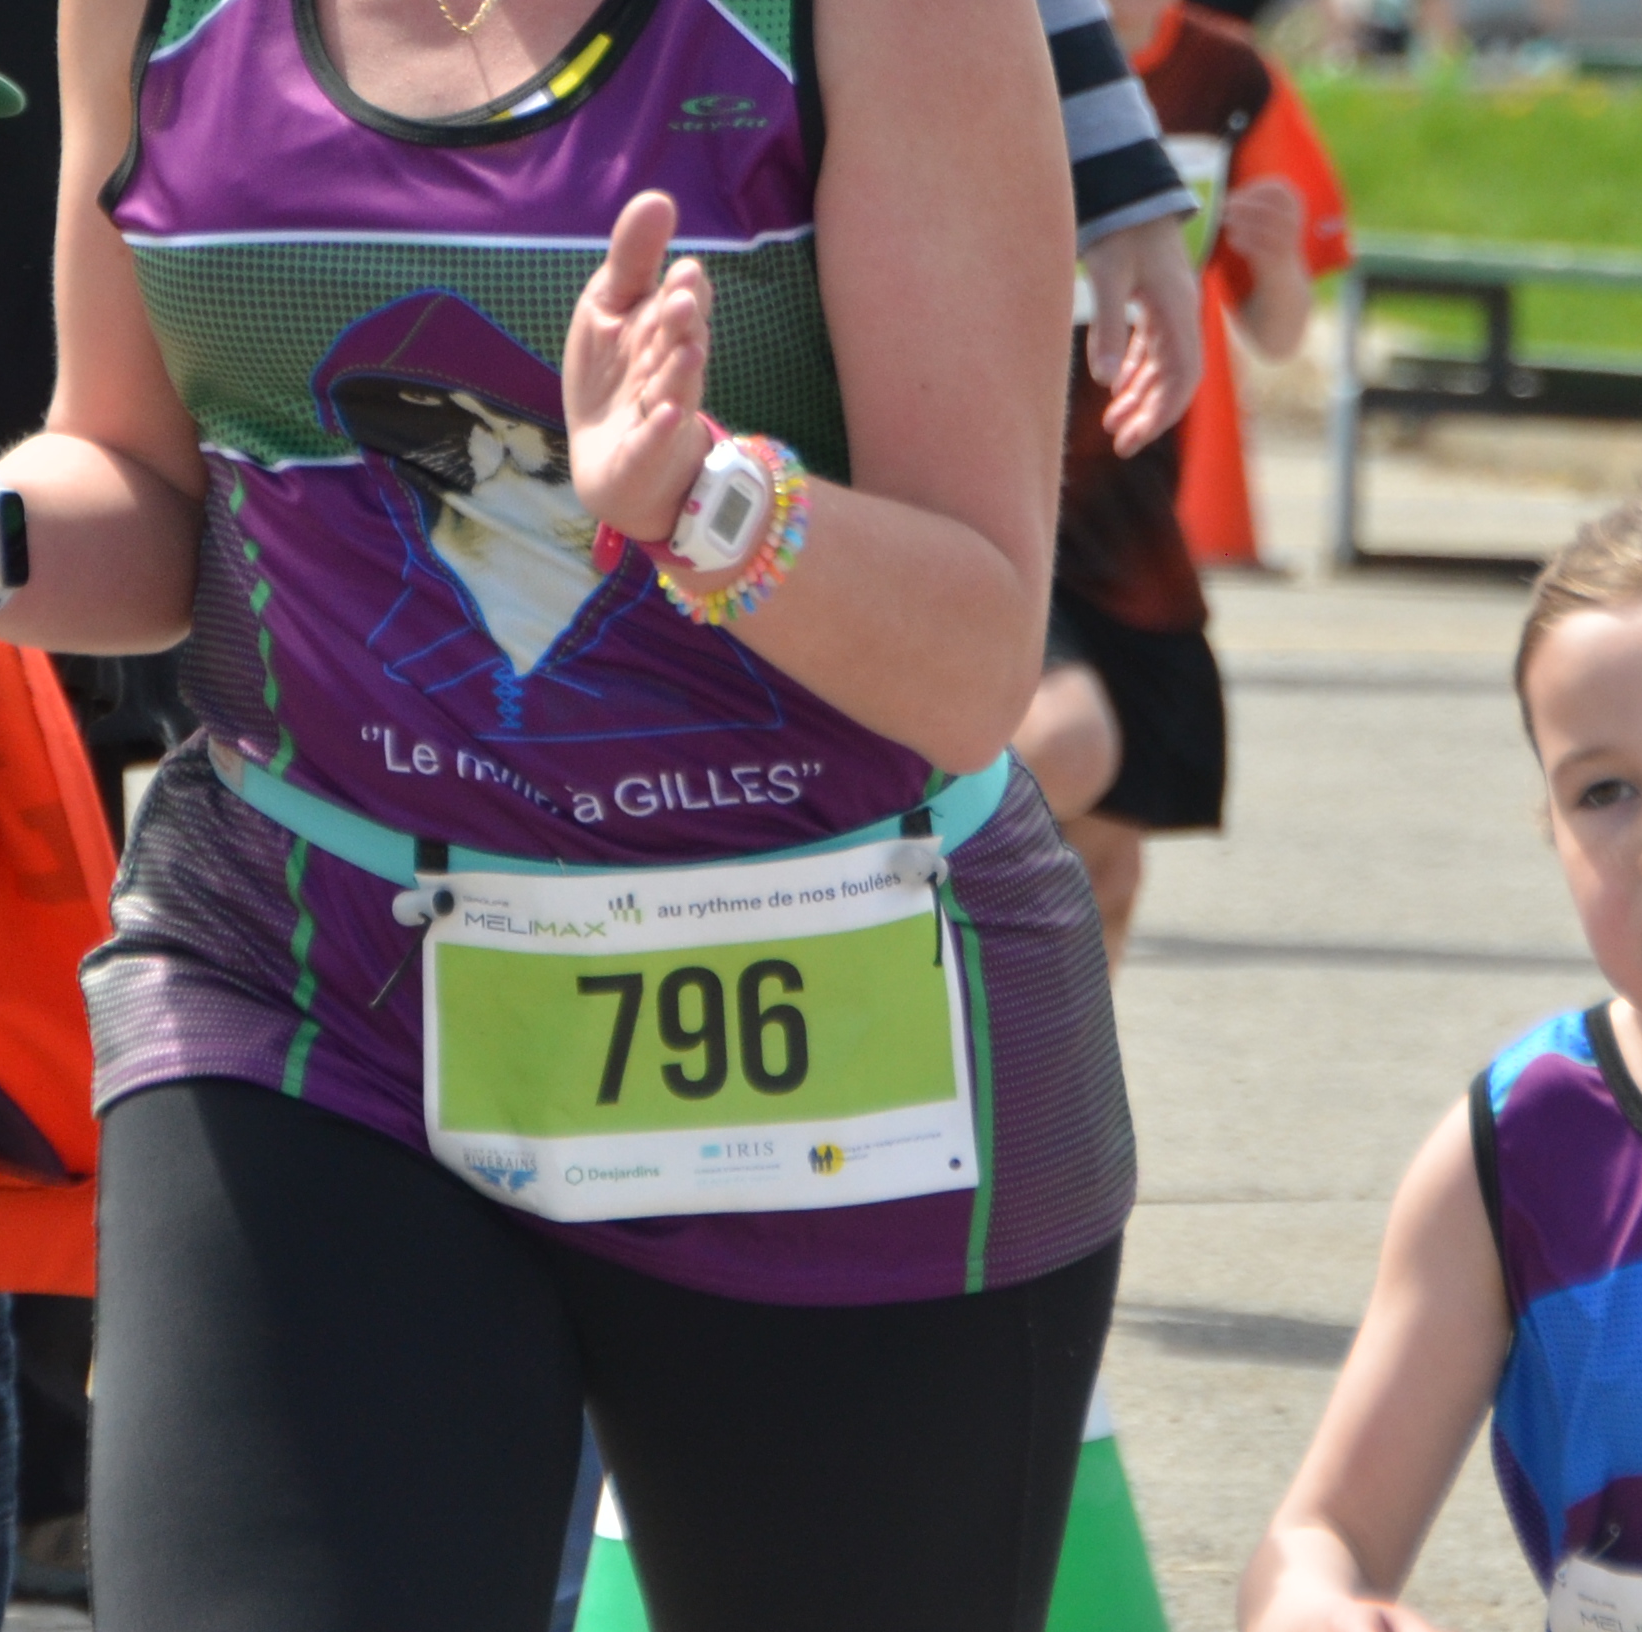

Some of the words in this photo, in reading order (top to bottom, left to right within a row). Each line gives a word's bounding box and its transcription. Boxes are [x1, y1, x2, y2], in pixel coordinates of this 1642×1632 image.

[657, 904, 682, 919] au
[688, 895, 762, 919] rythme
[768, 890, 794, 909] de
[799, 885, 836, 905] nos
[841, 872, 902, 899] foulées
[576, 958, 810, 1107] 796
[726, 1141, 775, 1159] IRIS
[588, 1165, 661, 1182] Desjardins
